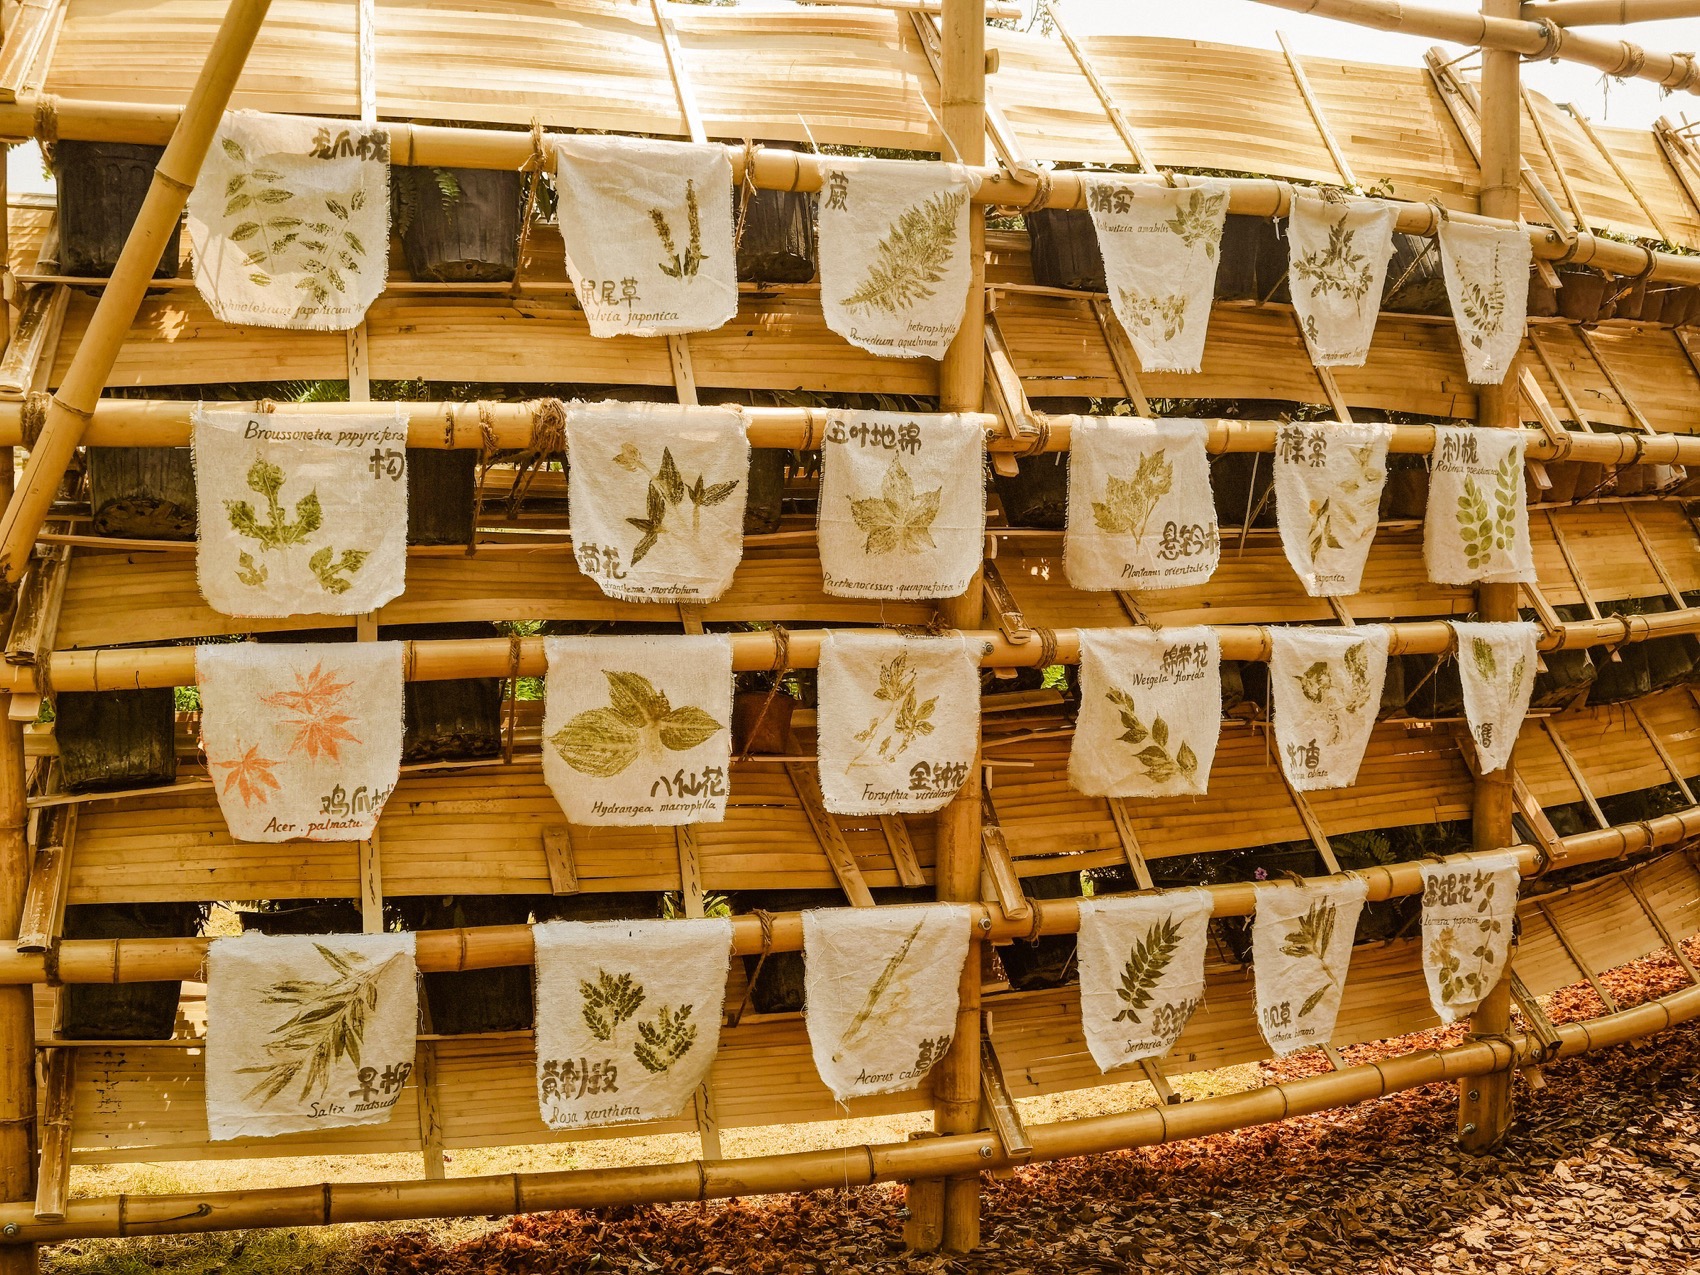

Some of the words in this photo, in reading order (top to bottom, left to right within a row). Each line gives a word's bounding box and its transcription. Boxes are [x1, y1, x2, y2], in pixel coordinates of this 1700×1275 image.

[580, 277, 641, 311] 鼠尾草
[625, 311, 679, 328] japonica
[335, 427, 406, 447] papyrifera
[1133, 673, 1169, 691] Weigela
[1173, 669, 1205, 685] florida
[650, 766, 726, 798] 八仙花
[908, 760, 968, 791] 金钟花
[862, 783, 908, 806] Forsythia
[591, 801, 653, 817] Hydrangea
[263, 817, 296, 833] Acer
[306, 818, 363, 837] palmatu
[854, 1068, 894, 1085] Acorus
[307, 1101, 345, 1118] Salix
[354, 1094, 401, 1113] matsud
[549, 1106, 578, 1124] Rosa
[585, 1104, 640, 1120] xanthina
